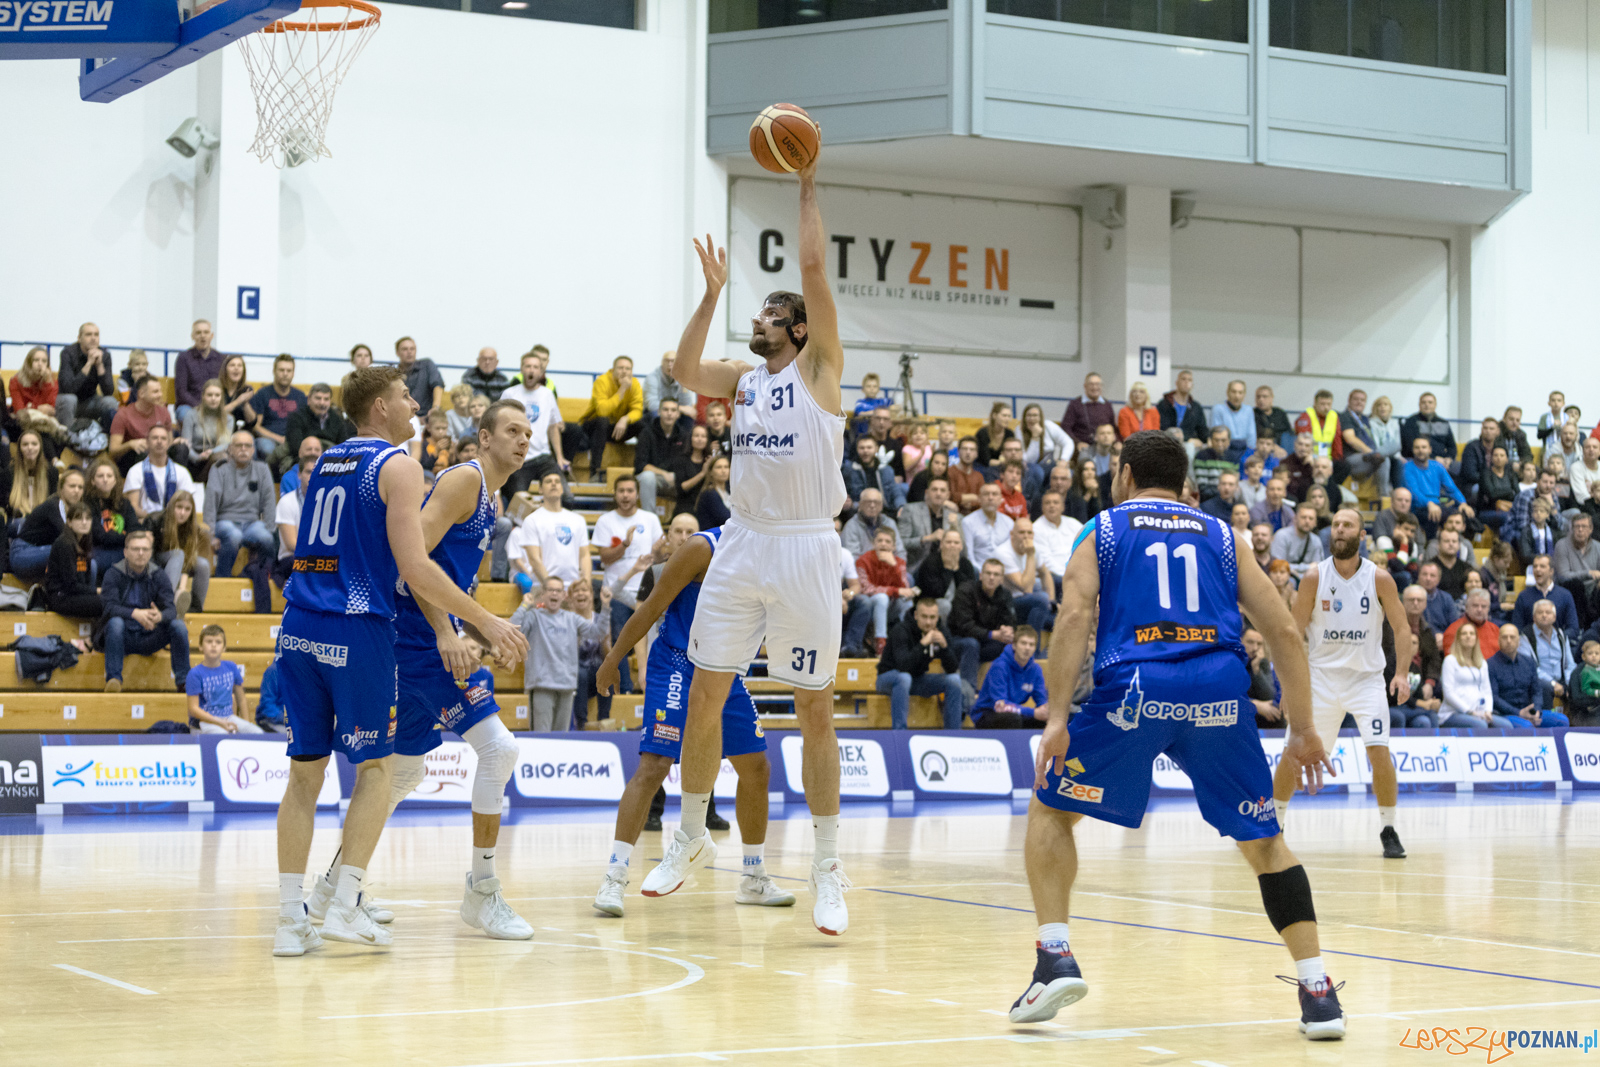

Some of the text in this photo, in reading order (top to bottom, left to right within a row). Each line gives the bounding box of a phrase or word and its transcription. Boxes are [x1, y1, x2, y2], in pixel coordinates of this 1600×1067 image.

[759, 229, 1009, 290] CTYZEN
[241, 290, 256, 316] C
[911, 289, 941, 301] KLUB
[947, 291, 1009, 306] SPORTOWY
[1142, 350, 1155, 371] B
[771, 382, 794, 411] 31
[308, 485, 346, 546] 10
[1145, 542, 1200, 612] 11
[1360, 596, 1370, 615] 9
[1135, 626, 1216, 643] WA-BET
[281, 634, 348, 658] OPOLSKIE
[791, 647, 817, 674] 31
[1142, 700, 1238, 721] OPOLSKIE
[1371, 719, 1383, 736] 9
[93, 761, 197, 779] funclub
[95, 778, 197, 788] biuro podróży
